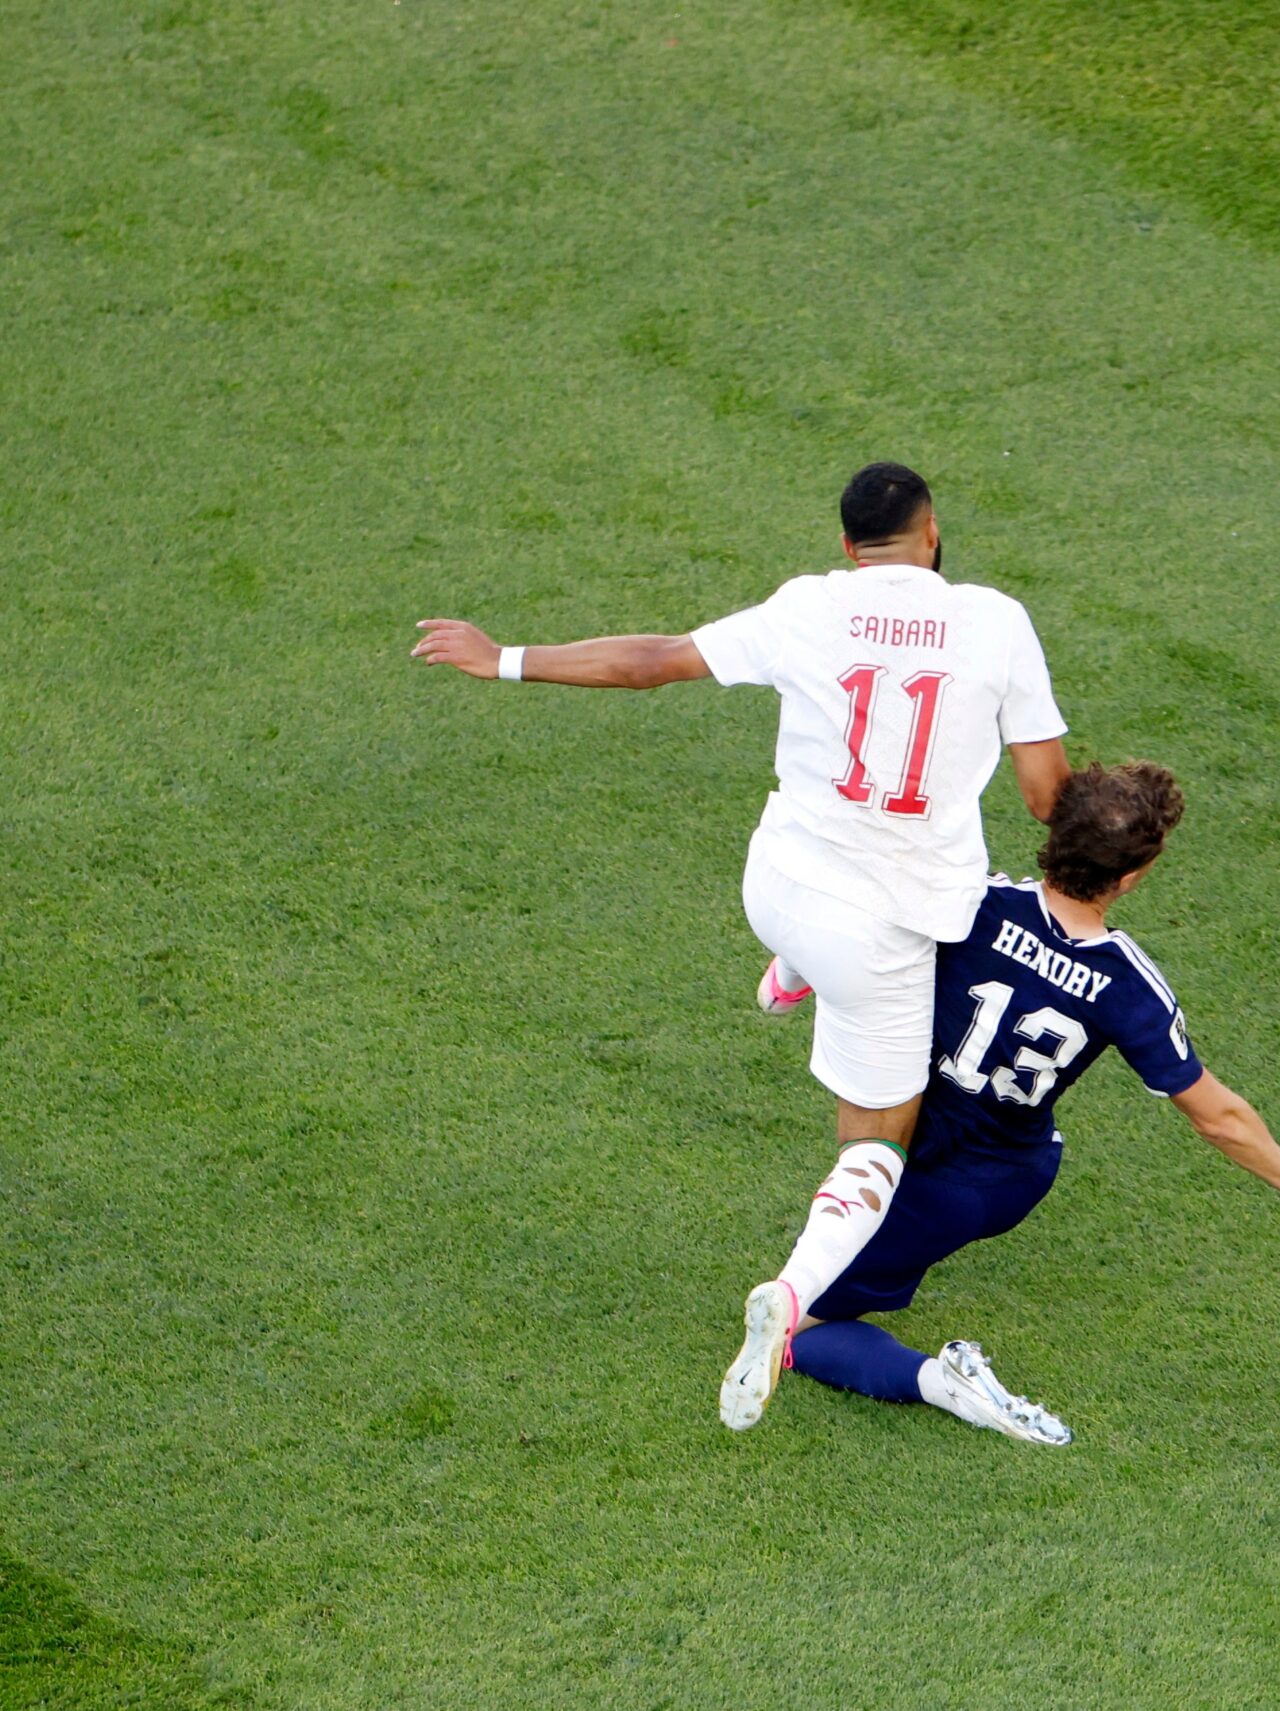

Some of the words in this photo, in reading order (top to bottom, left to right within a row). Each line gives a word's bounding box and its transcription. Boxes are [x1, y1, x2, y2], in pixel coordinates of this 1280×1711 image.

[850, 616, 946, 649] SAIBARI
[831, 664, 955, 821] 11
[991, 919, 1112, 1003] HENDRY
[938, 980, 1089, 1107] 13
